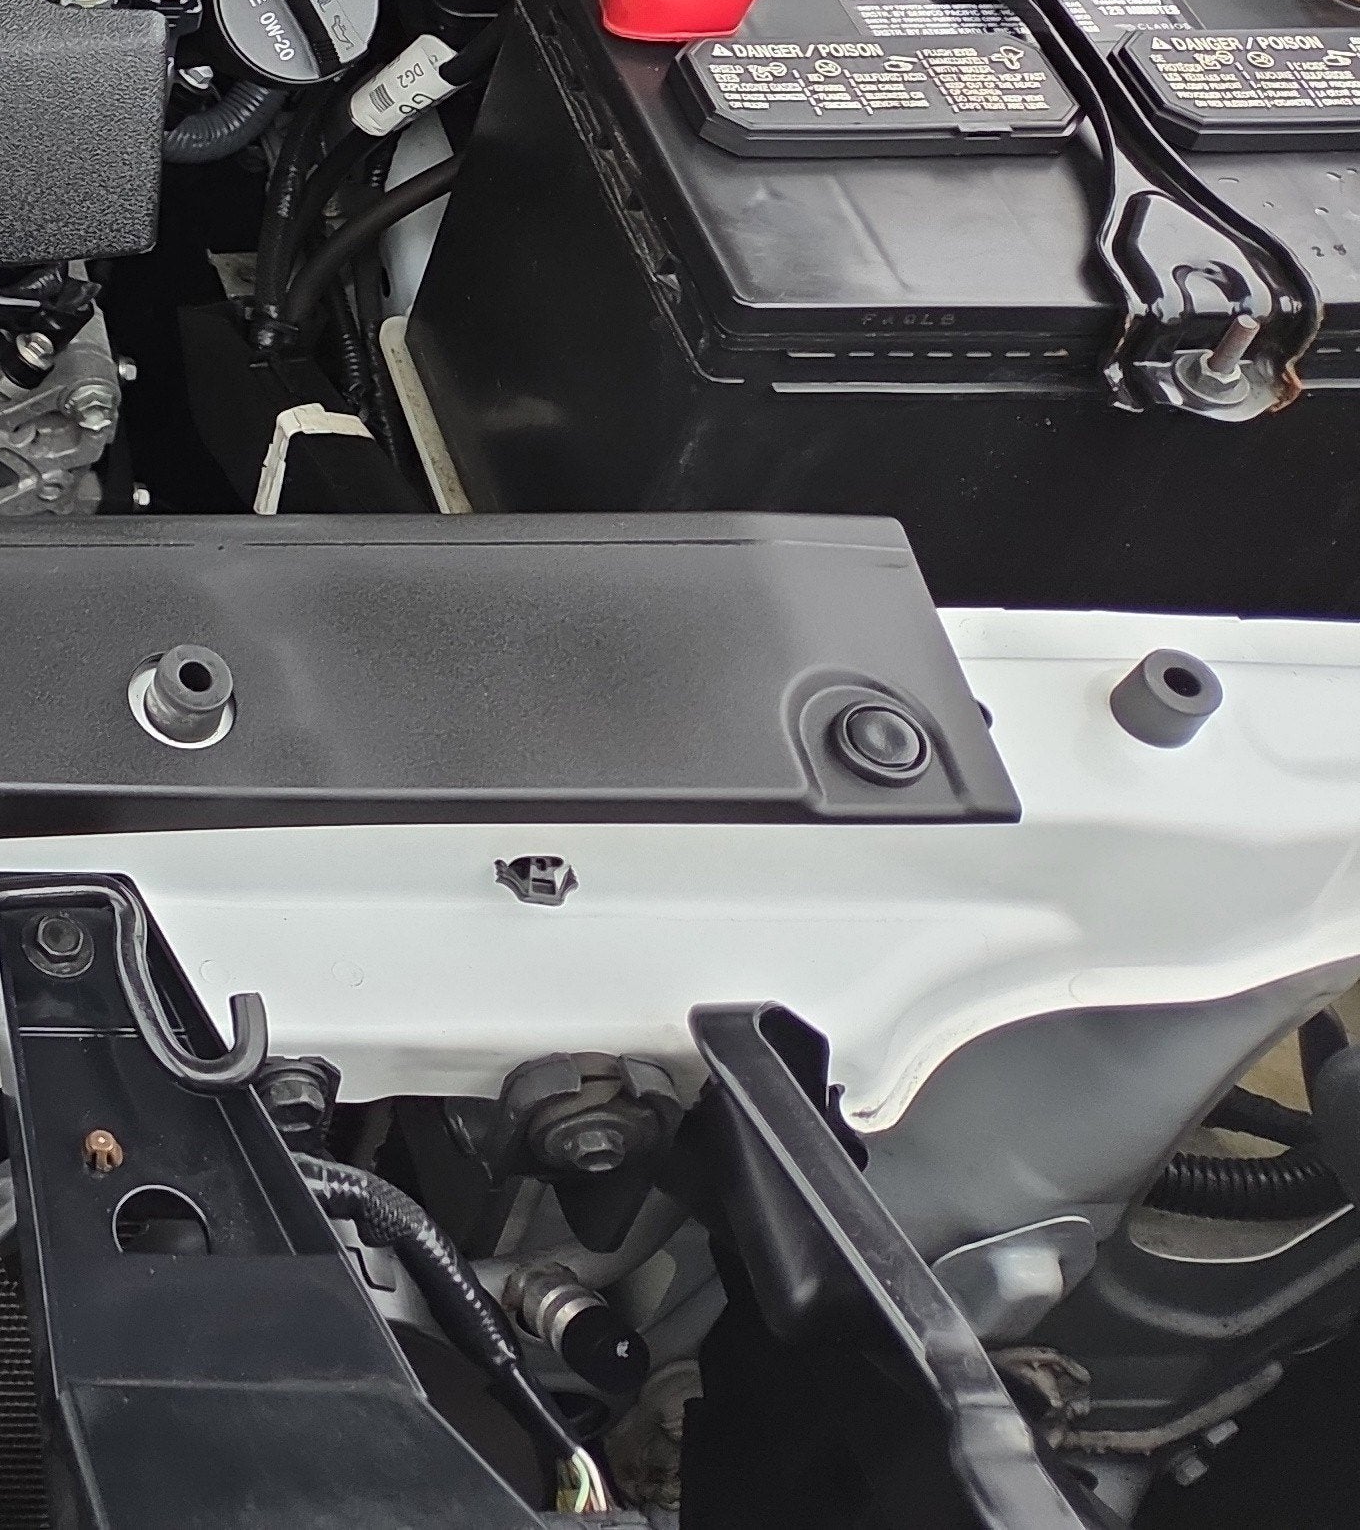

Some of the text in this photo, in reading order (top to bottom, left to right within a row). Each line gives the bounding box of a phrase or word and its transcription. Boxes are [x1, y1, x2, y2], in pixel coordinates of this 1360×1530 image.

[259, 11, 296, 62] 0W-20
[1170, 36, 1243, 50] DANGER
[1254, 36, 1324, 50] POISON
[732, 44, 804, 58] DANGER
[816, 43, 884, 58] POISON
[396, 61, 424, 89] DG2
